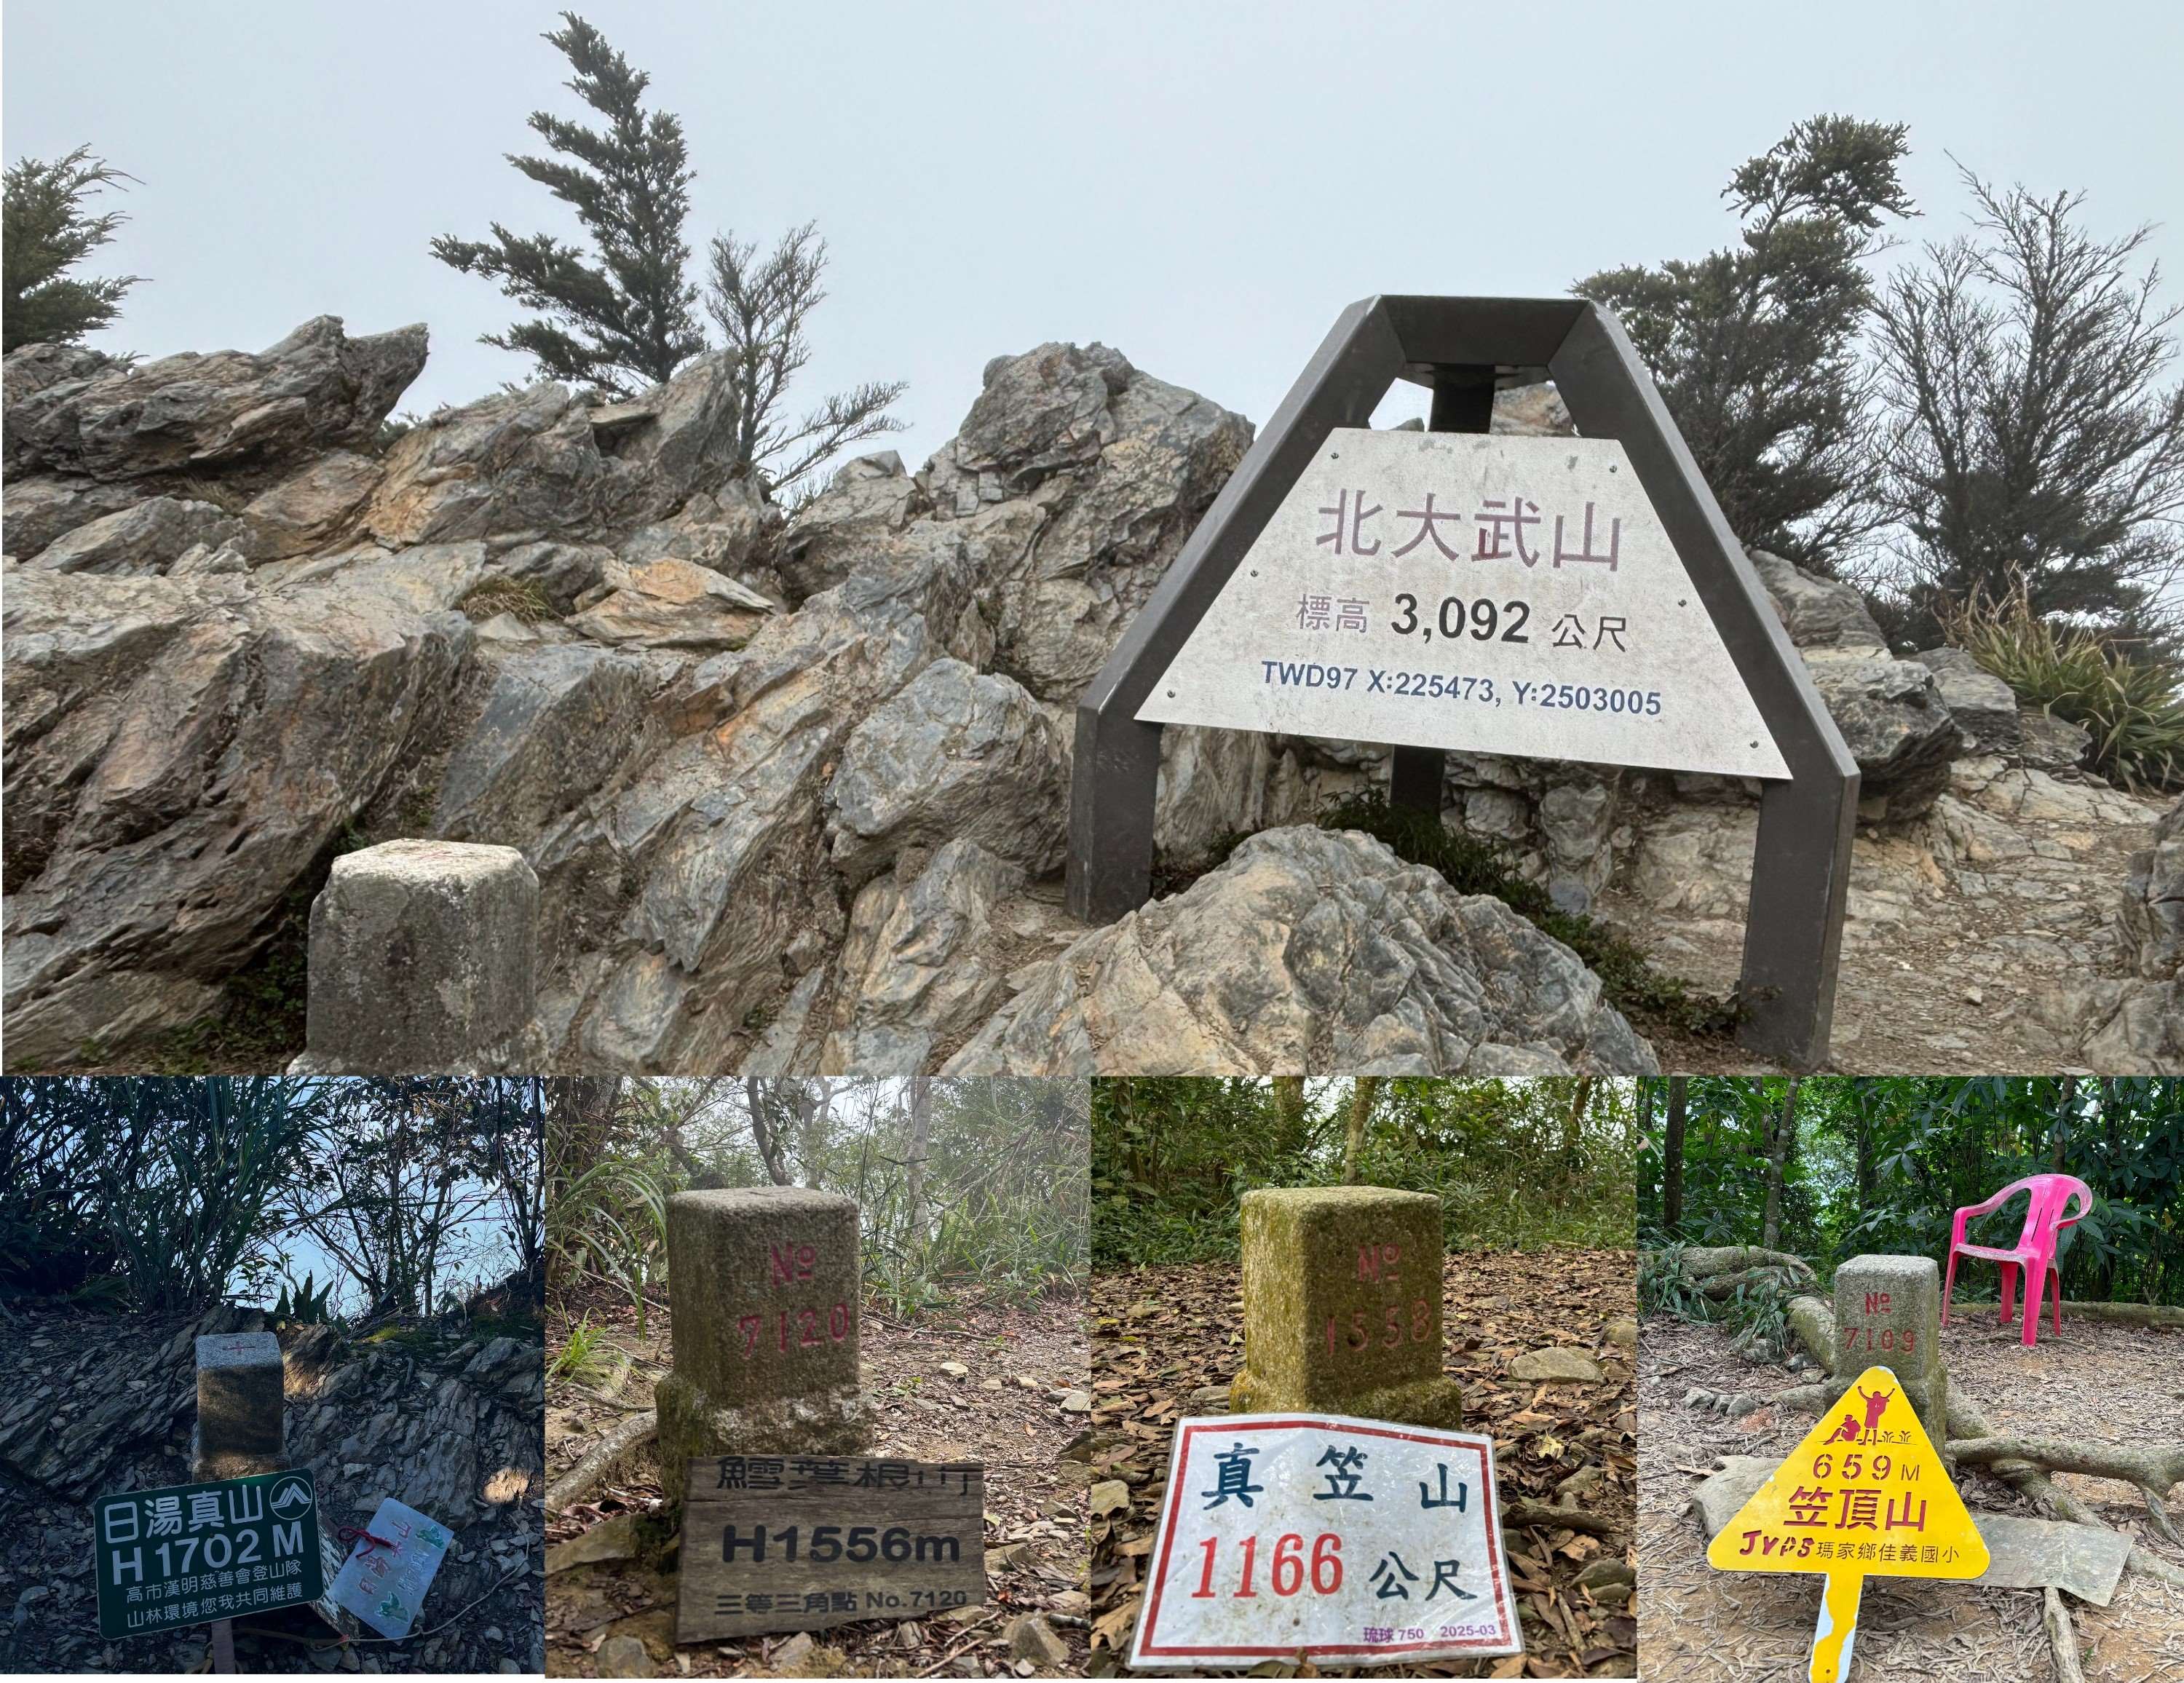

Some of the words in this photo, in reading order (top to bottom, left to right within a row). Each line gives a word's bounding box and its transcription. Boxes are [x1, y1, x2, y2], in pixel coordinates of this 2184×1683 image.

[1316, 488, 1621, 572] 北大武山
[1296, 593, 1370, 634] 標高
[1390, 593, 1530, 644] 3,092
[1551, 615, 1628, 652] 公尺
[1262, 661, 1358, 690] TWD97
[1367, 671, 1502, 706] X:225473,
[1512, 682, 1661, 716] Y:2503005
[737, 1303, 850, 1359] 7120
[1326, 1298, 1432, 1357] 1558
[1843, 1328, 1915, 1354] 7109
[1201, 1442, 1468, 1513] 真笠山
[1813, 1454, 1891, 1481] 659
[1901, 1464, 1920, 1481] M
[104, 1484, 263, 1544] 日湯真山
[1784, 1486, 1927, 1532] 笠頂山
[722, 1524, 960, 1563] H1556m
[1191, 1533, 1343, 1599] 1166
[1369, 1551, 1478, 1601] 公尺
[1739, 1529, 1815, 1559] JYPS
[1816, 1541, 1960, 1564] 瑪家鄉佳義國小
[125, 1559, 302, 1604] 高市漢明慈善會登山隊
[715, 1592, 857, 1615] 三等三角點
[866, 1590, 967, 1609] No.7120
[127, 1582, 303, 1629] 山林環境您我共同維護
[1363, 1626, 1395, 1643] 琉球
[1398, 1628, 1425, 1641] 750
[1439, 1624, 1497, 1638] 2025-03
